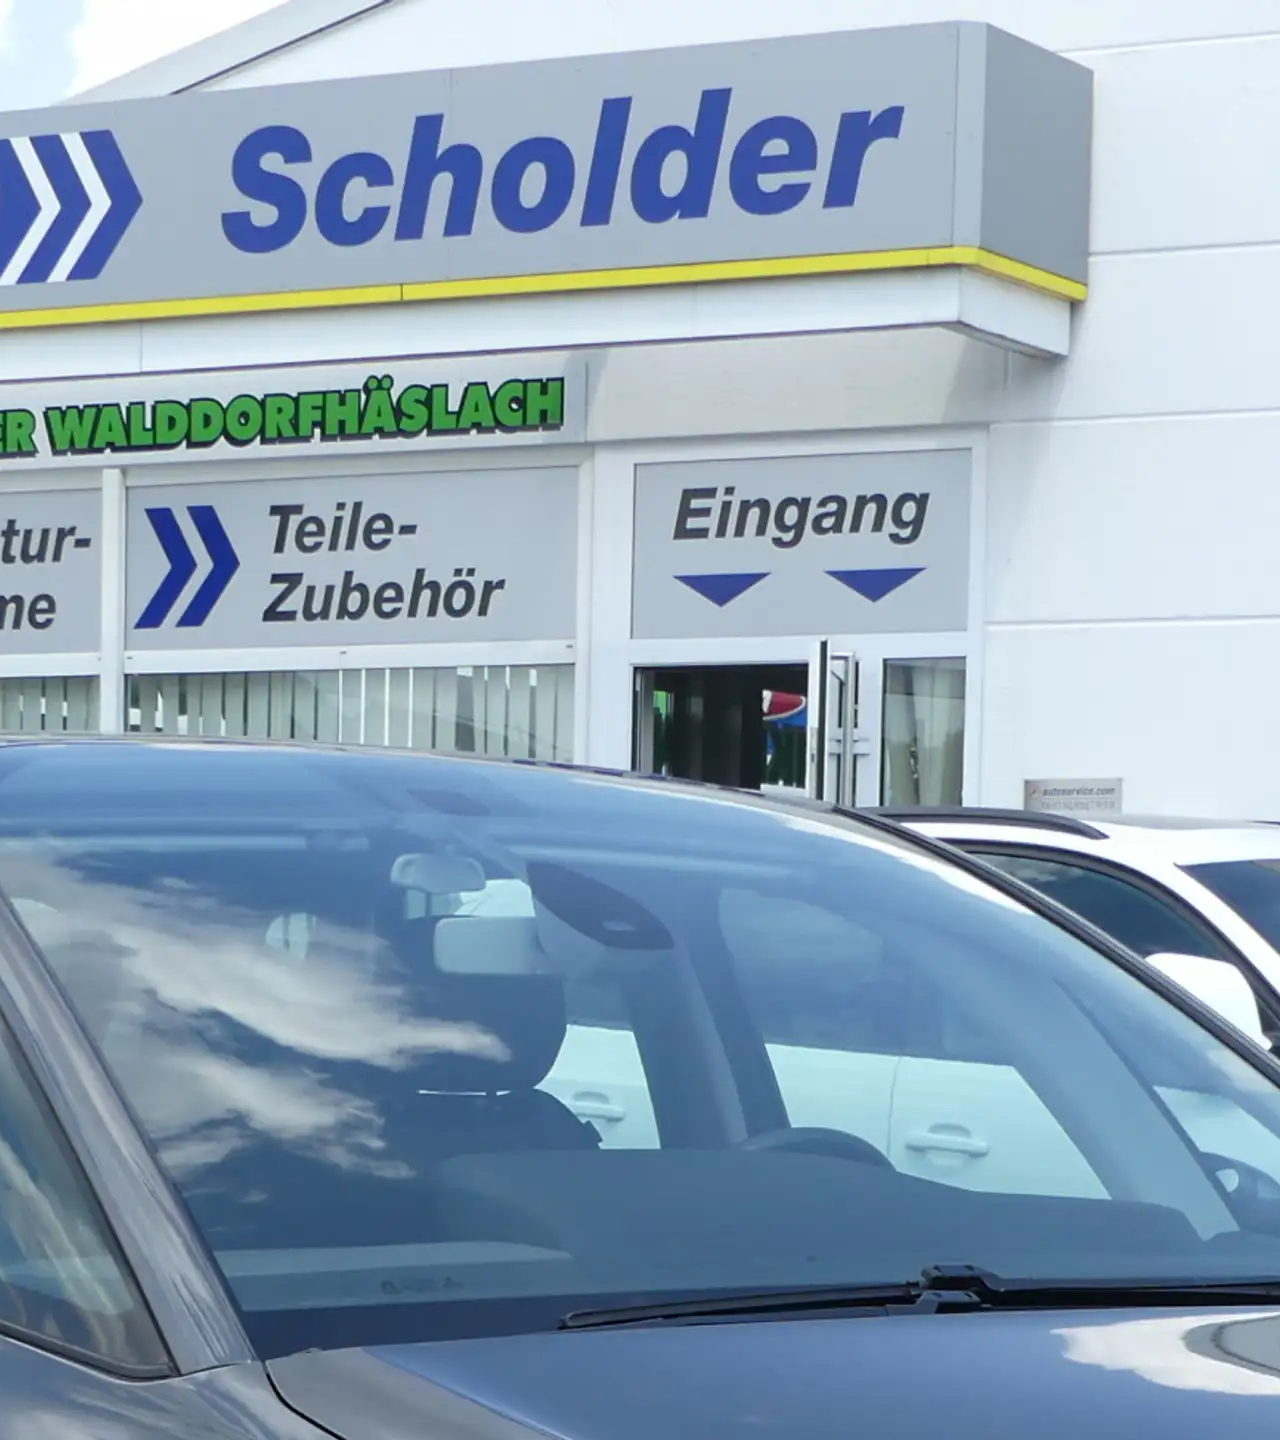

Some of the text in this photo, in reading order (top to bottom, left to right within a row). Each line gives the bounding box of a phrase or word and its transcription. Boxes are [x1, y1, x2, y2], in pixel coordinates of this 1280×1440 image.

[221, 88, 904, 253] Scholder
[43, 374, 565, 456] WALDDORFHÄSLACH
[268, 502, 418, 555] Teile-
[673, 487, 929, 548] Eingang
[262, 568, 505, 622] Zubehör
